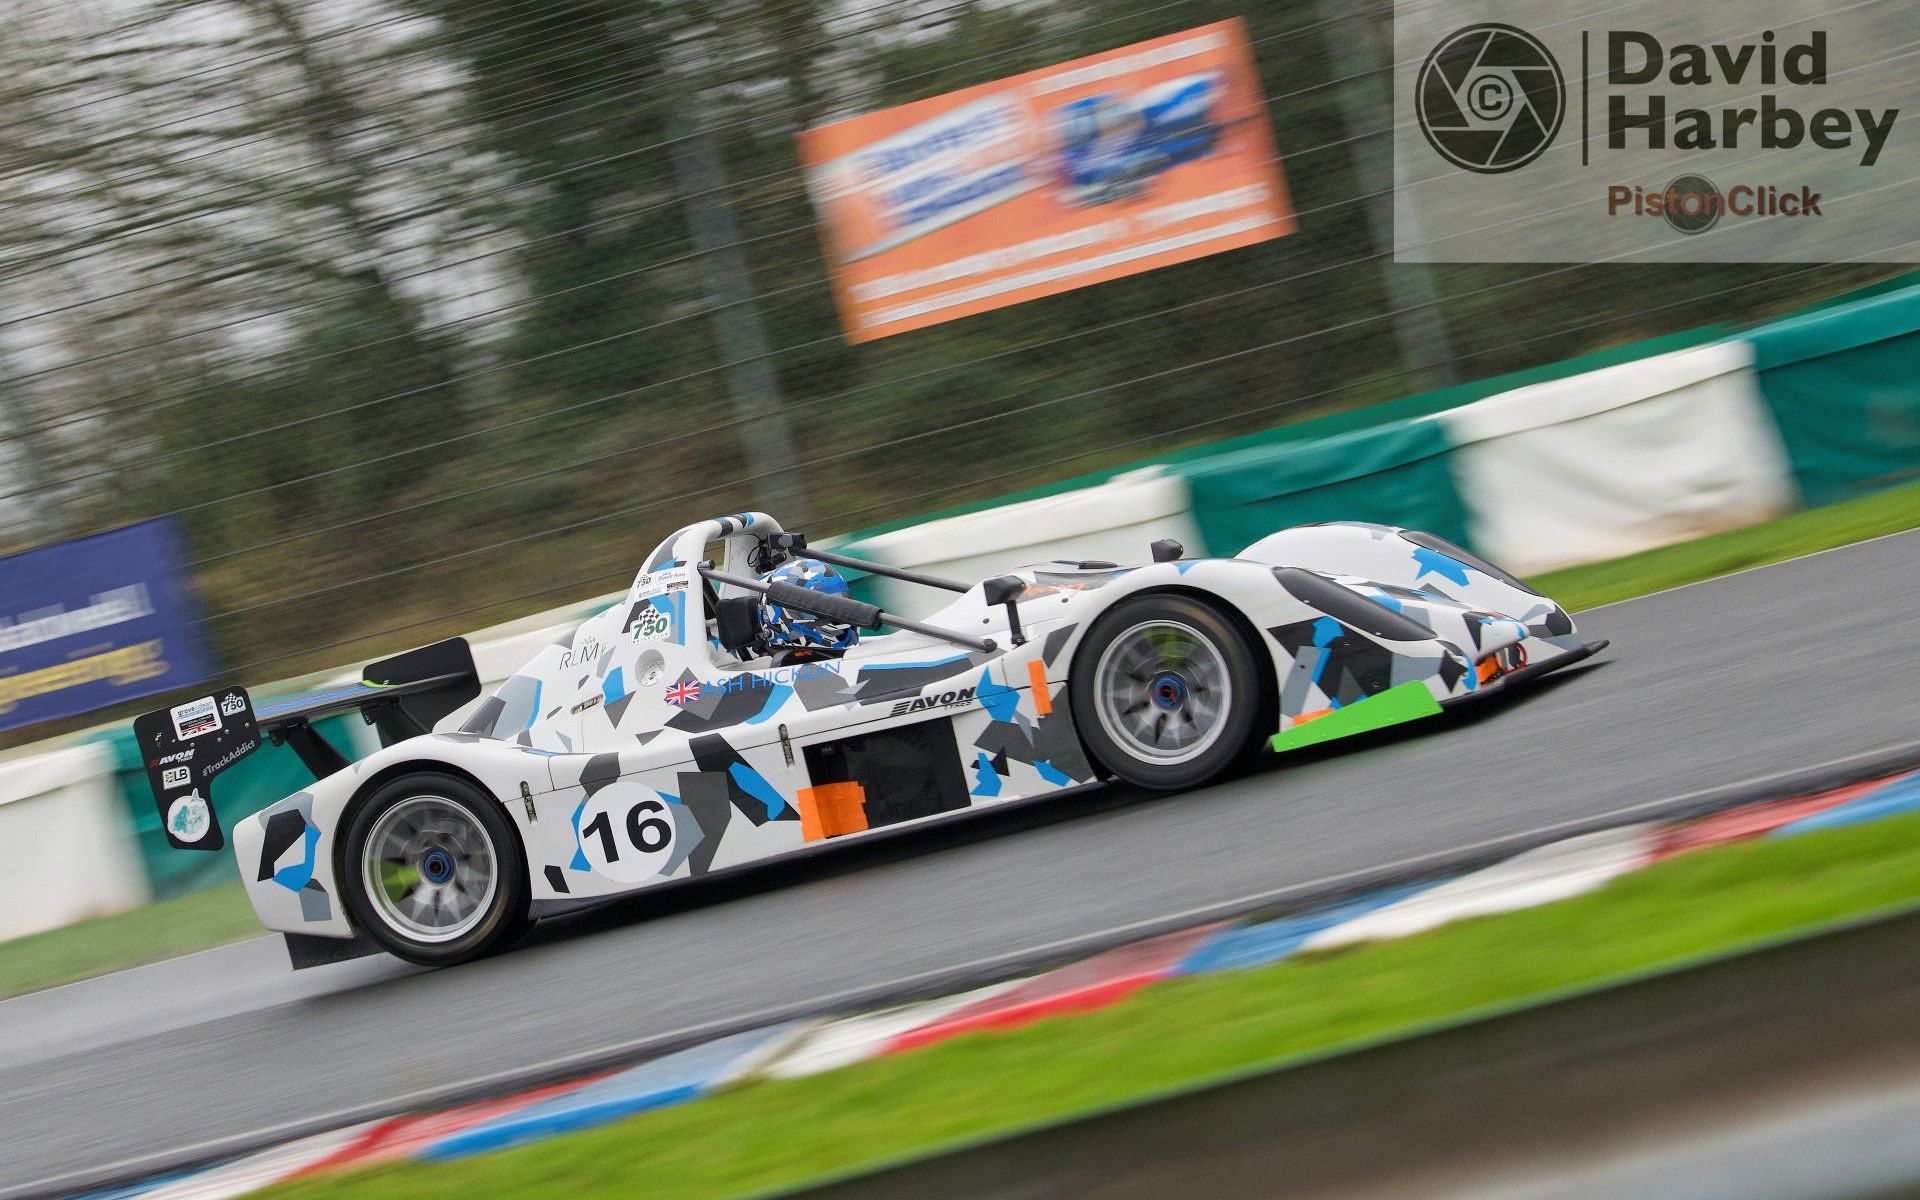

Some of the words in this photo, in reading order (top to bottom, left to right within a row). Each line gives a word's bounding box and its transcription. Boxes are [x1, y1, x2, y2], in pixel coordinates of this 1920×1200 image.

[633, 617, 668, 640] 750
[699, 675, 744, 698] ASH
[751, 660, 841, 689] HICKLIN
[223, 699, 244, 712] 750
[908, 686, 976, 711] AVON
[159, 749, 195, 765] AVON
[201, 740, 255, 778] #TrackAddict
[583, 800, 672, 863] 16
